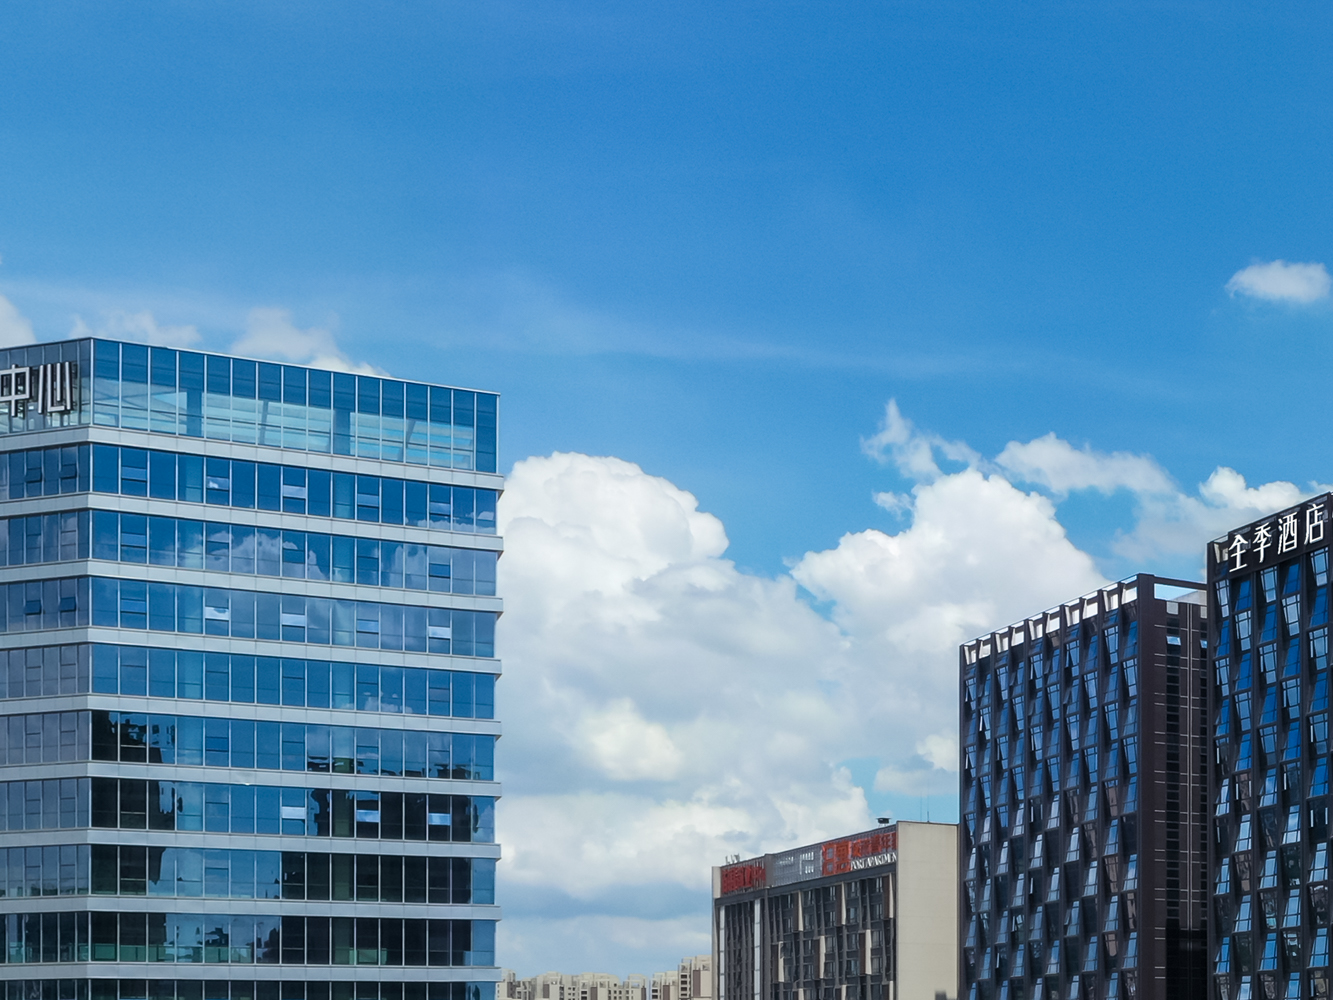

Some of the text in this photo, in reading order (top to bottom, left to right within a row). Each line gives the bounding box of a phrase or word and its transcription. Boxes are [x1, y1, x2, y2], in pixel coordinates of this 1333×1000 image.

[0, 361, 72, 417] 中心
[1228, 503, 1325, 573] 全季酒店
